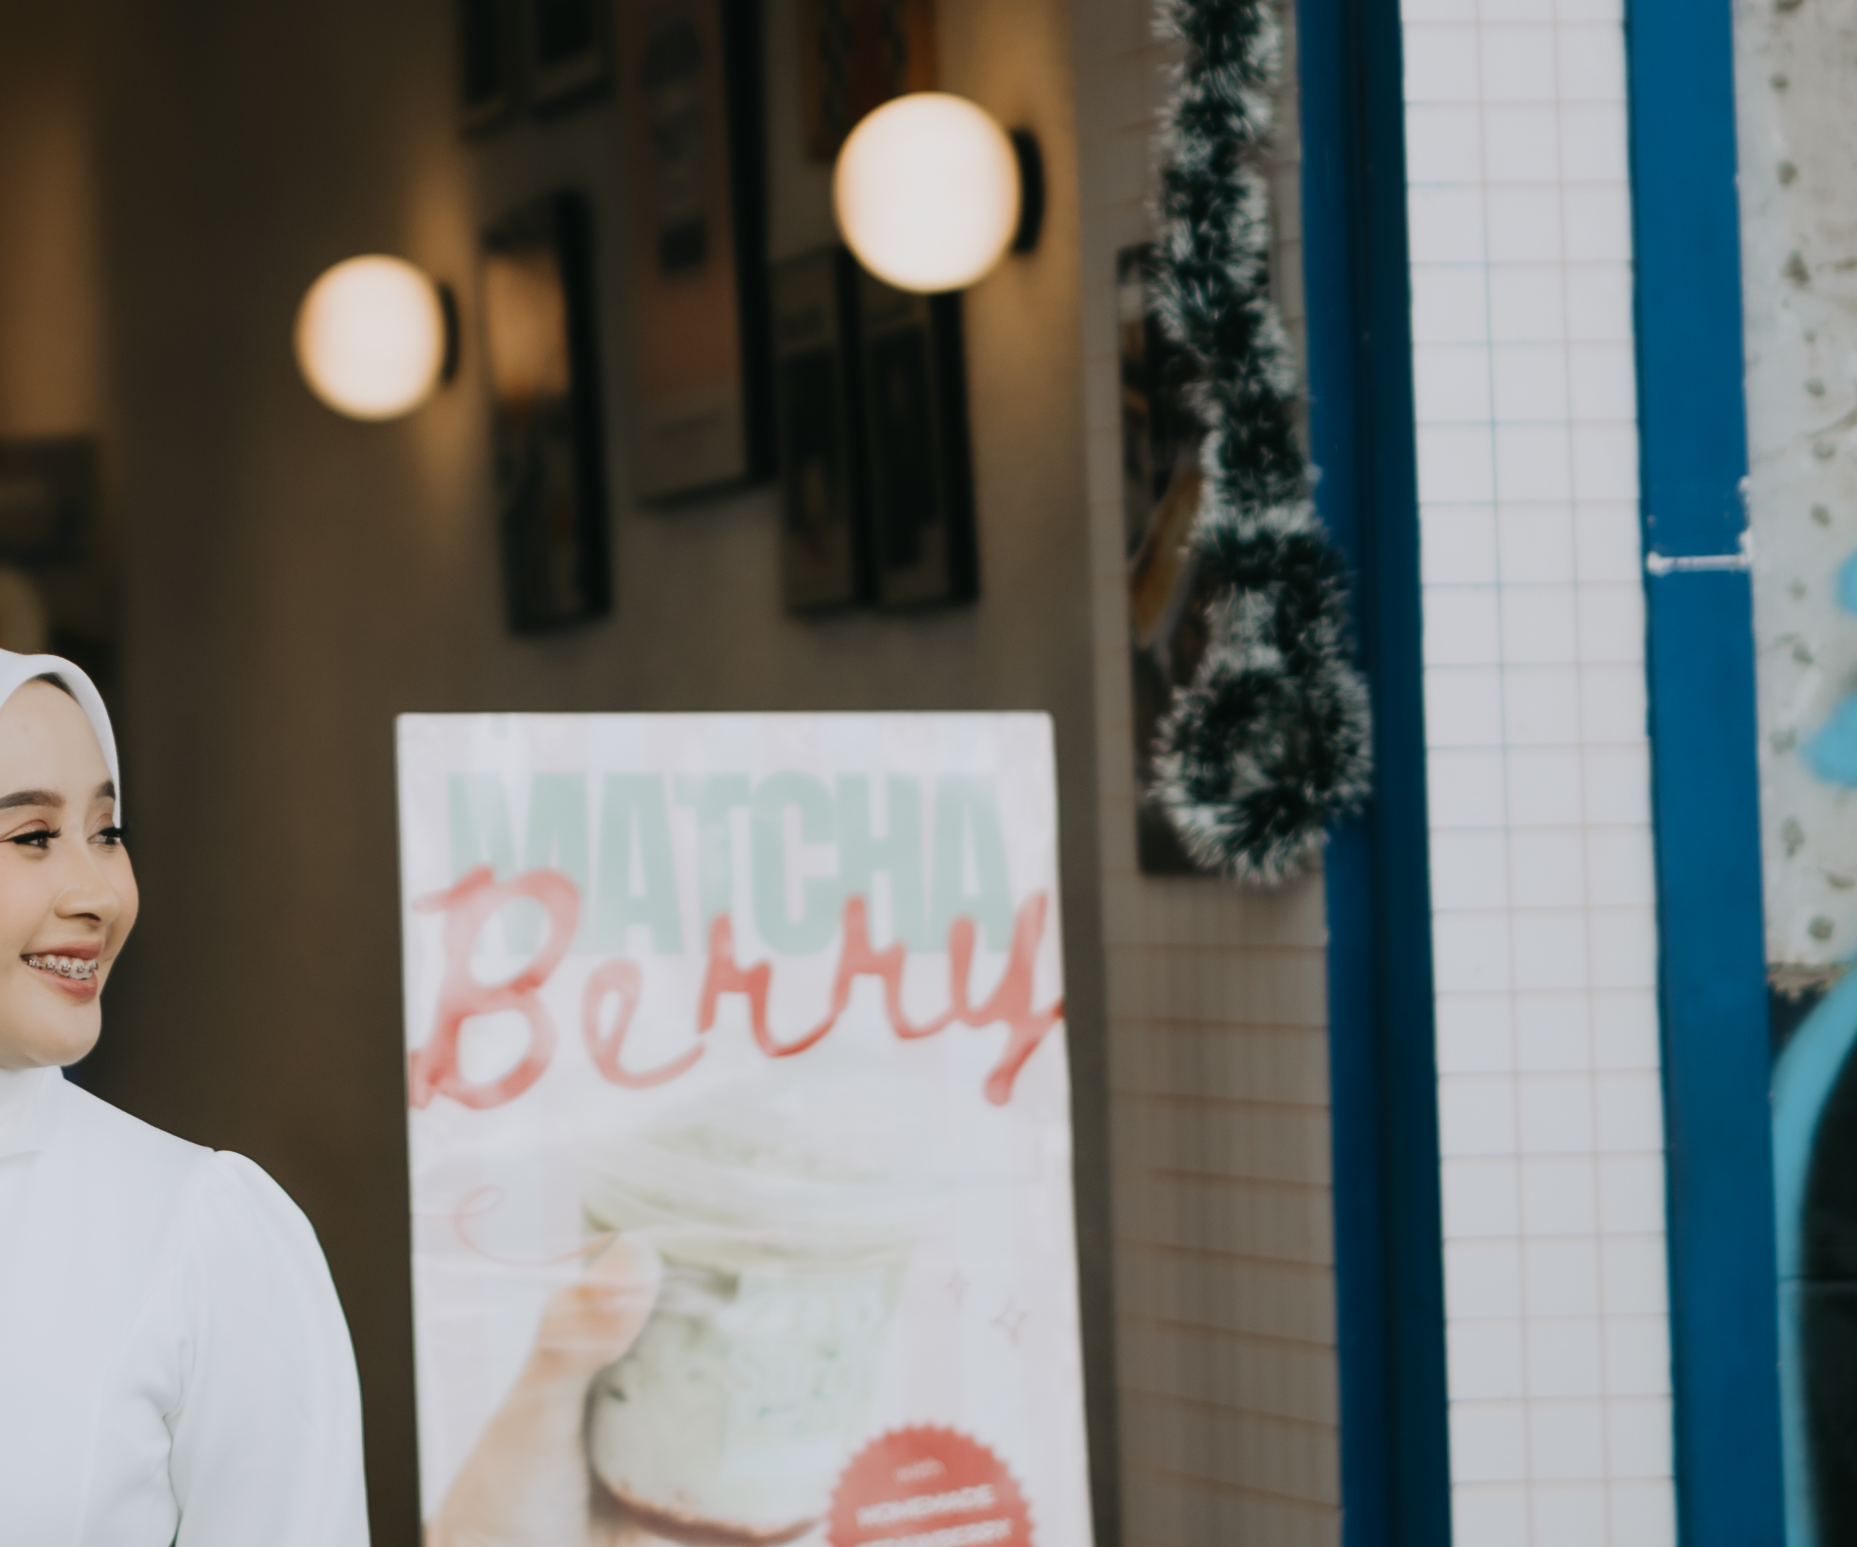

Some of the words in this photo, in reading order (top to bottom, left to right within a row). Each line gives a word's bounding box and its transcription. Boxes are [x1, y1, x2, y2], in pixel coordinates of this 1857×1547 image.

[445, 770, 1017, 955] MATCHA
[409, 865, 1065, 1112] Berry
[855, 1483, 995, 1529] HOMEMADE
